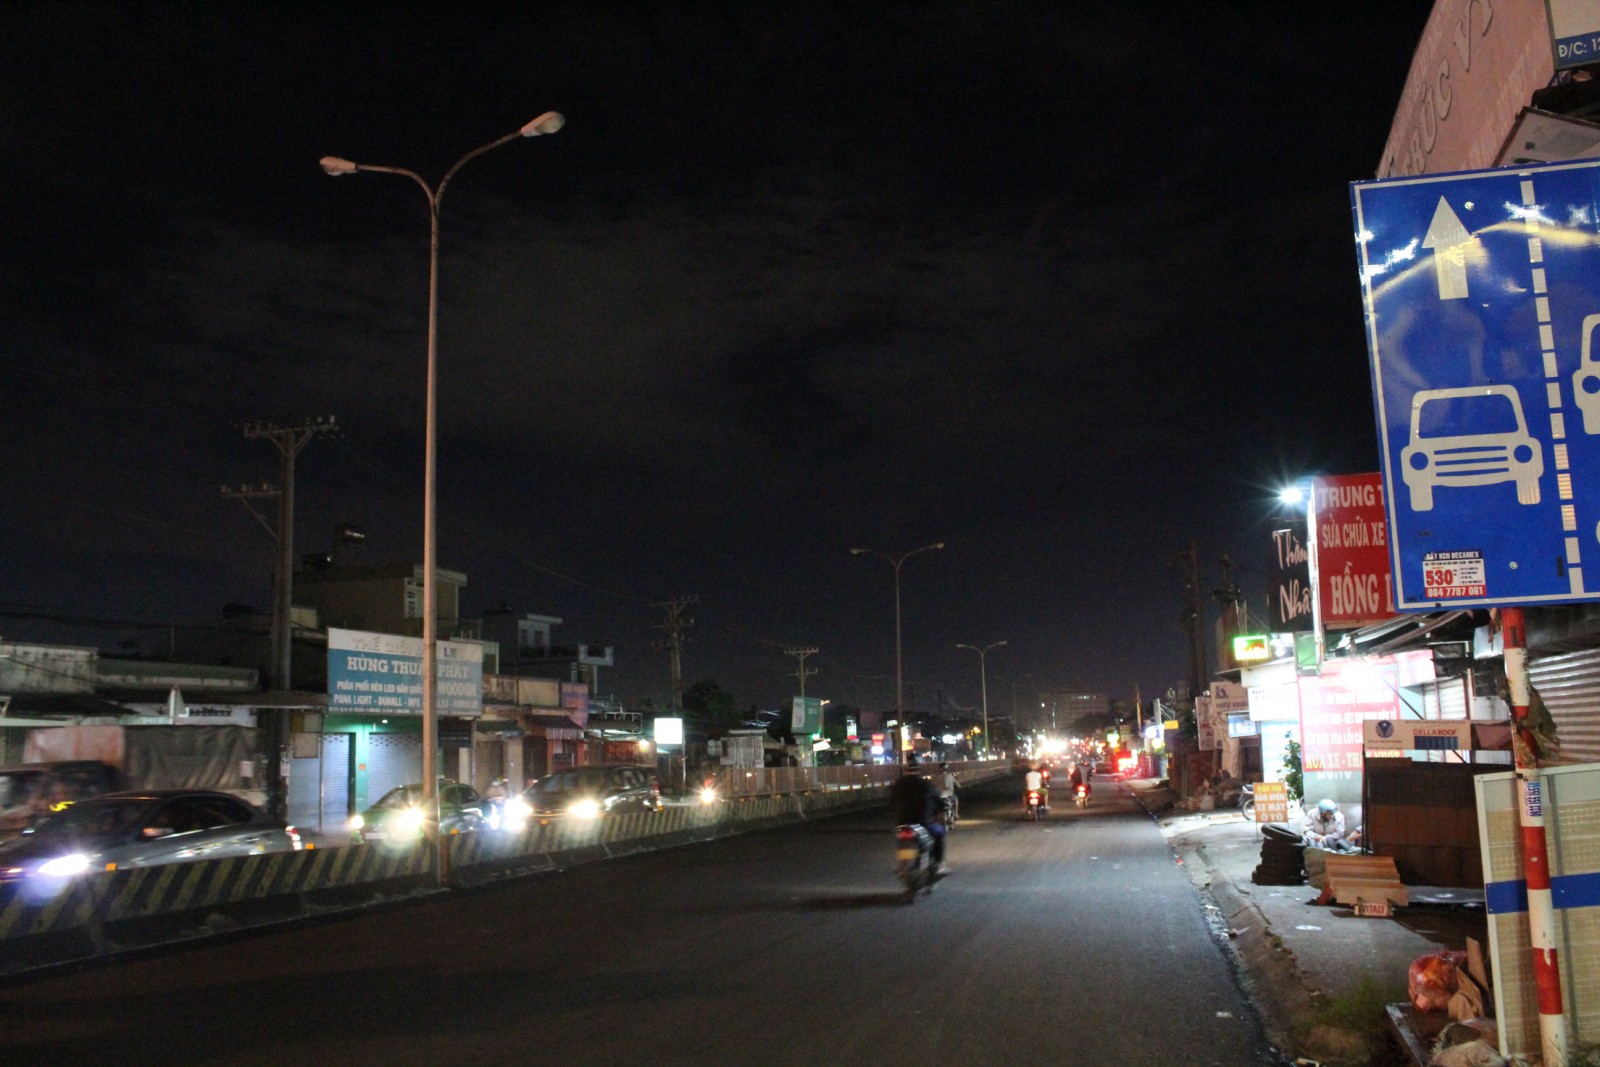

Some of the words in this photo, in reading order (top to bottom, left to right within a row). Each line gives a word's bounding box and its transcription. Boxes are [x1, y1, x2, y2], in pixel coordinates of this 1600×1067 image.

[1558, 41, 1587, 58] Đ/C:
[1320, 484, 1375, 509] TRUNG
[1371, 522, 1385, 546] XE
[1451, 551, 1479, 559] BECAMEX
[1425, 569, 1453, 586] 530
[1330, 561, 1380, 615] HỒNG
[1428, 588, 1443, 598] 084
[1446, 587, 1466, 597] 7787
[347, 654, 389, 673] HÙNG
[391, 660, 424, 677] THU
[1413, 728, 1457, 736] DELLAROOF
